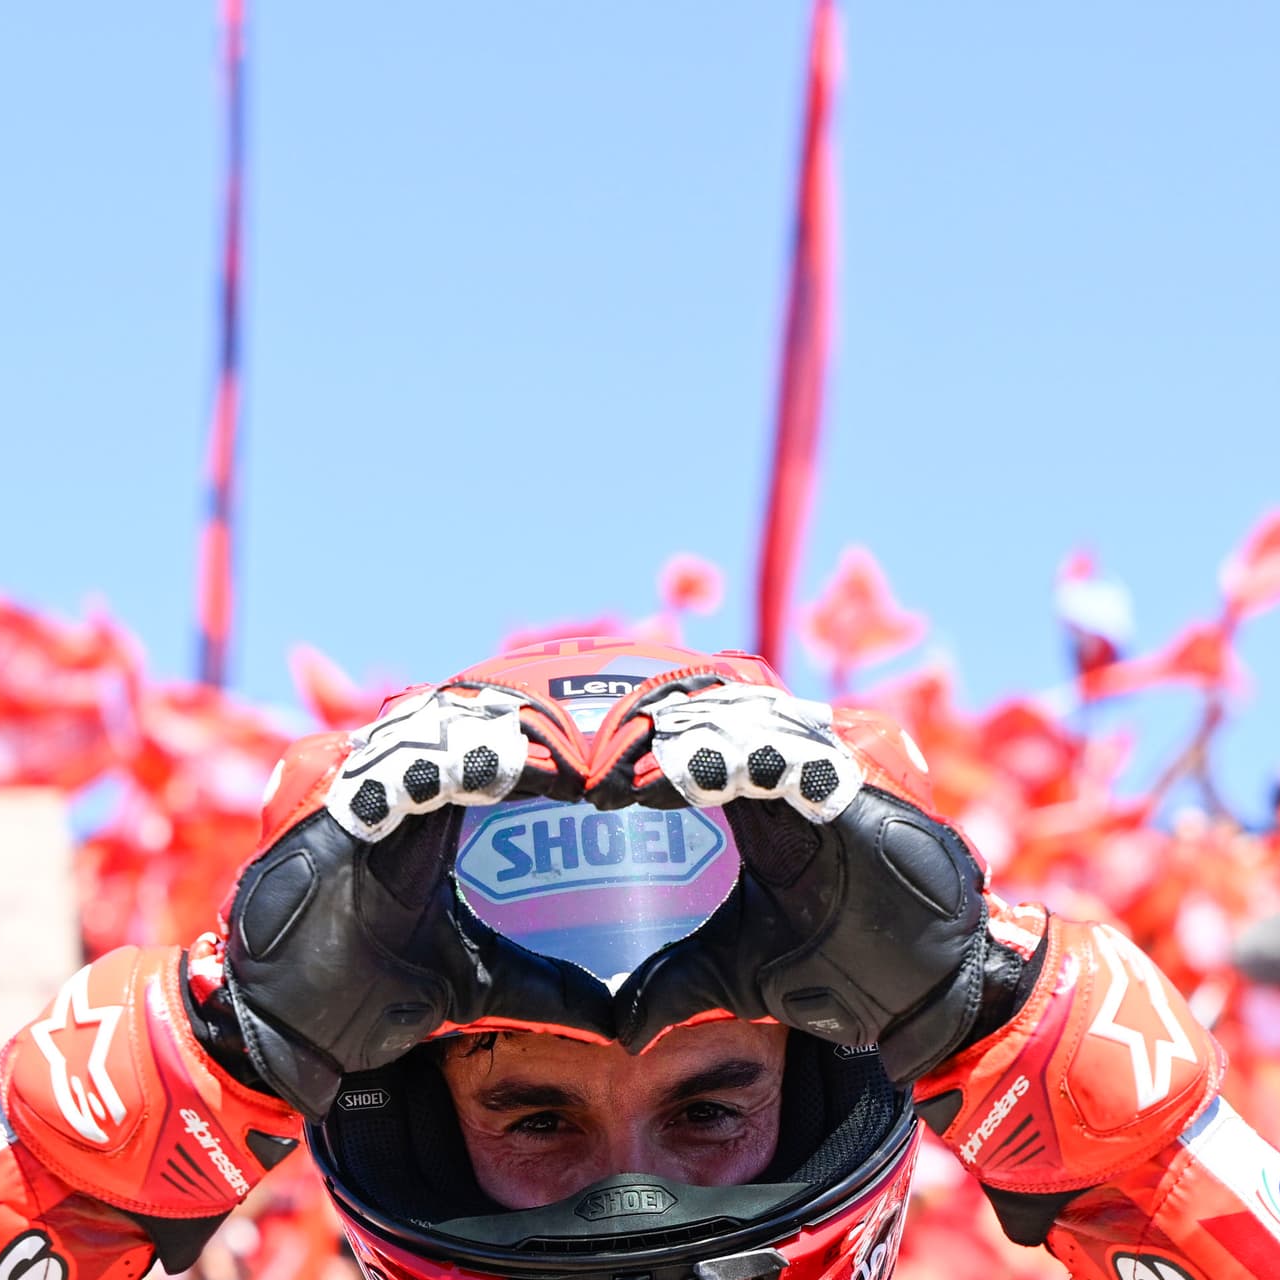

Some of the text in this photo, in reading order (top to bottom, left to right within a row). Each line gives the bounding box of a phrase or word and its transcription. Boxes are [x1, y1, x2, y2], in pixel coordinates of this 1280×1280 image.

[562, 680, 642, 696] Len
[491, 811, 686, 882] SHOEI
[345, 1092, 383, 1107] SHOEI
[959, 1075, 1030, 1164] lpinestars
[180, 1108, 250, 1196] alpinestars
[584, 1190, 664, 1217] SHOEI
